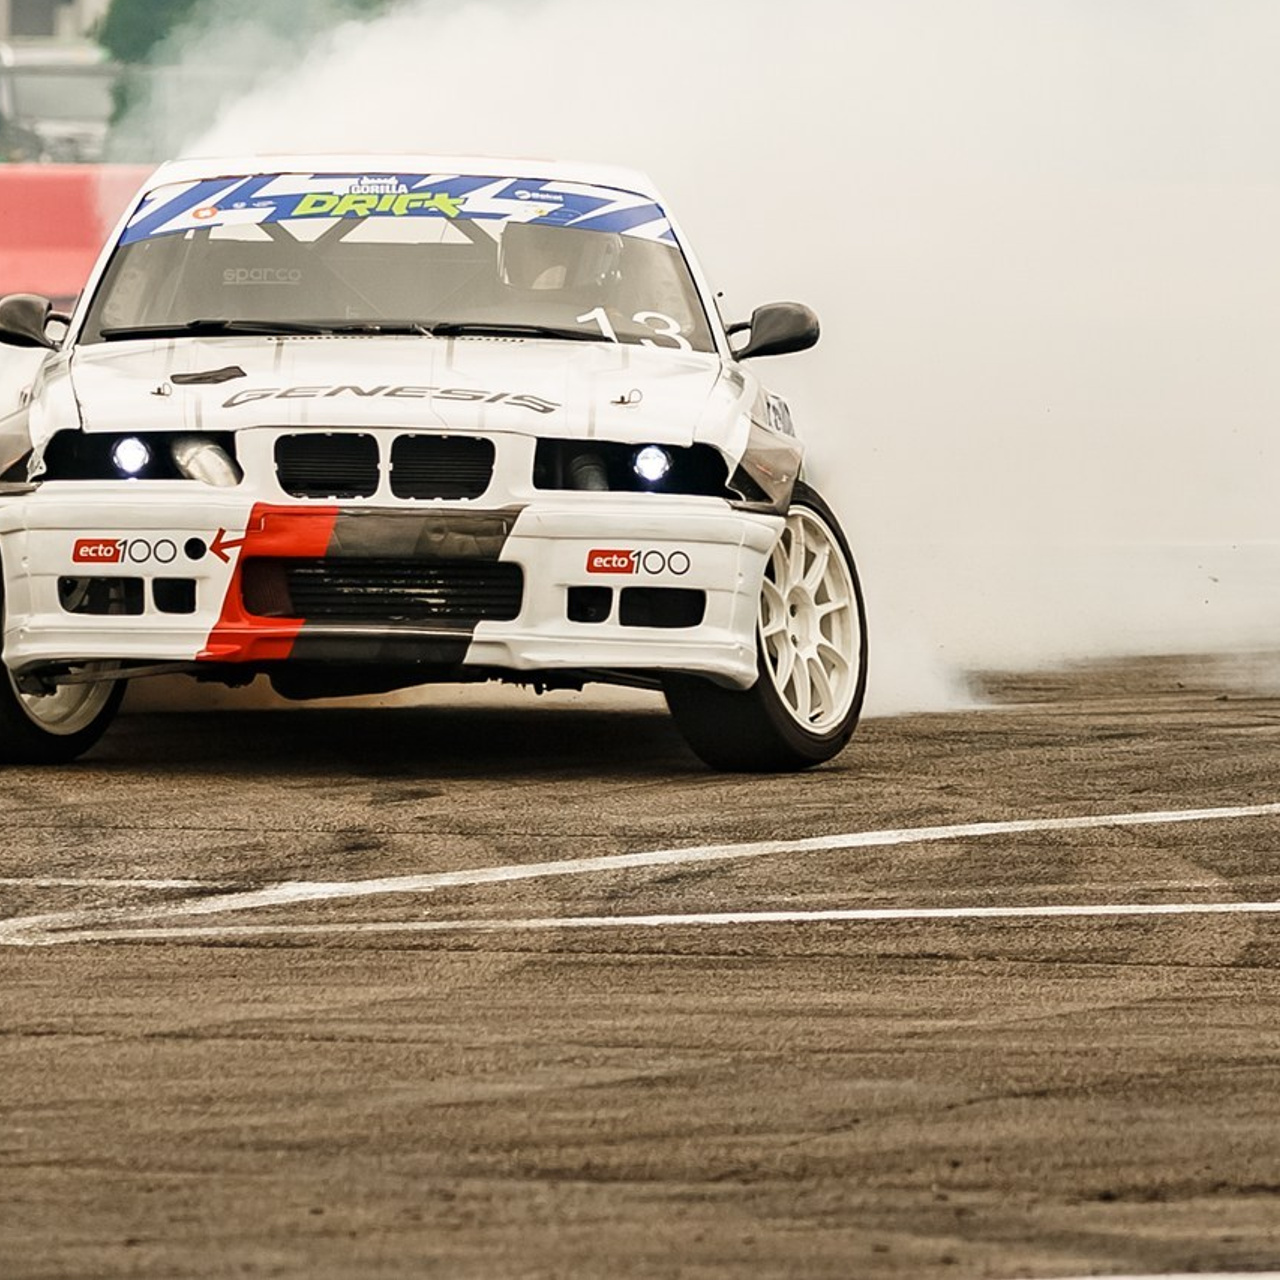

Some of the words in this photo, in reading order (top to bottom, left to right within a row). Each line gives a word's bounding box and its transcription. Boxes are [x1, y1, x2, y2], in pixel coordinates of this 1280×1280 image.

[351, 183, 408, 195] GORILLA
[291, 193, 465, 218] DRIFT
[222, 267, 301, 285] sparco
[576, 307, 693, 352] 13
[222, 385, 562, 414] GENESIS
